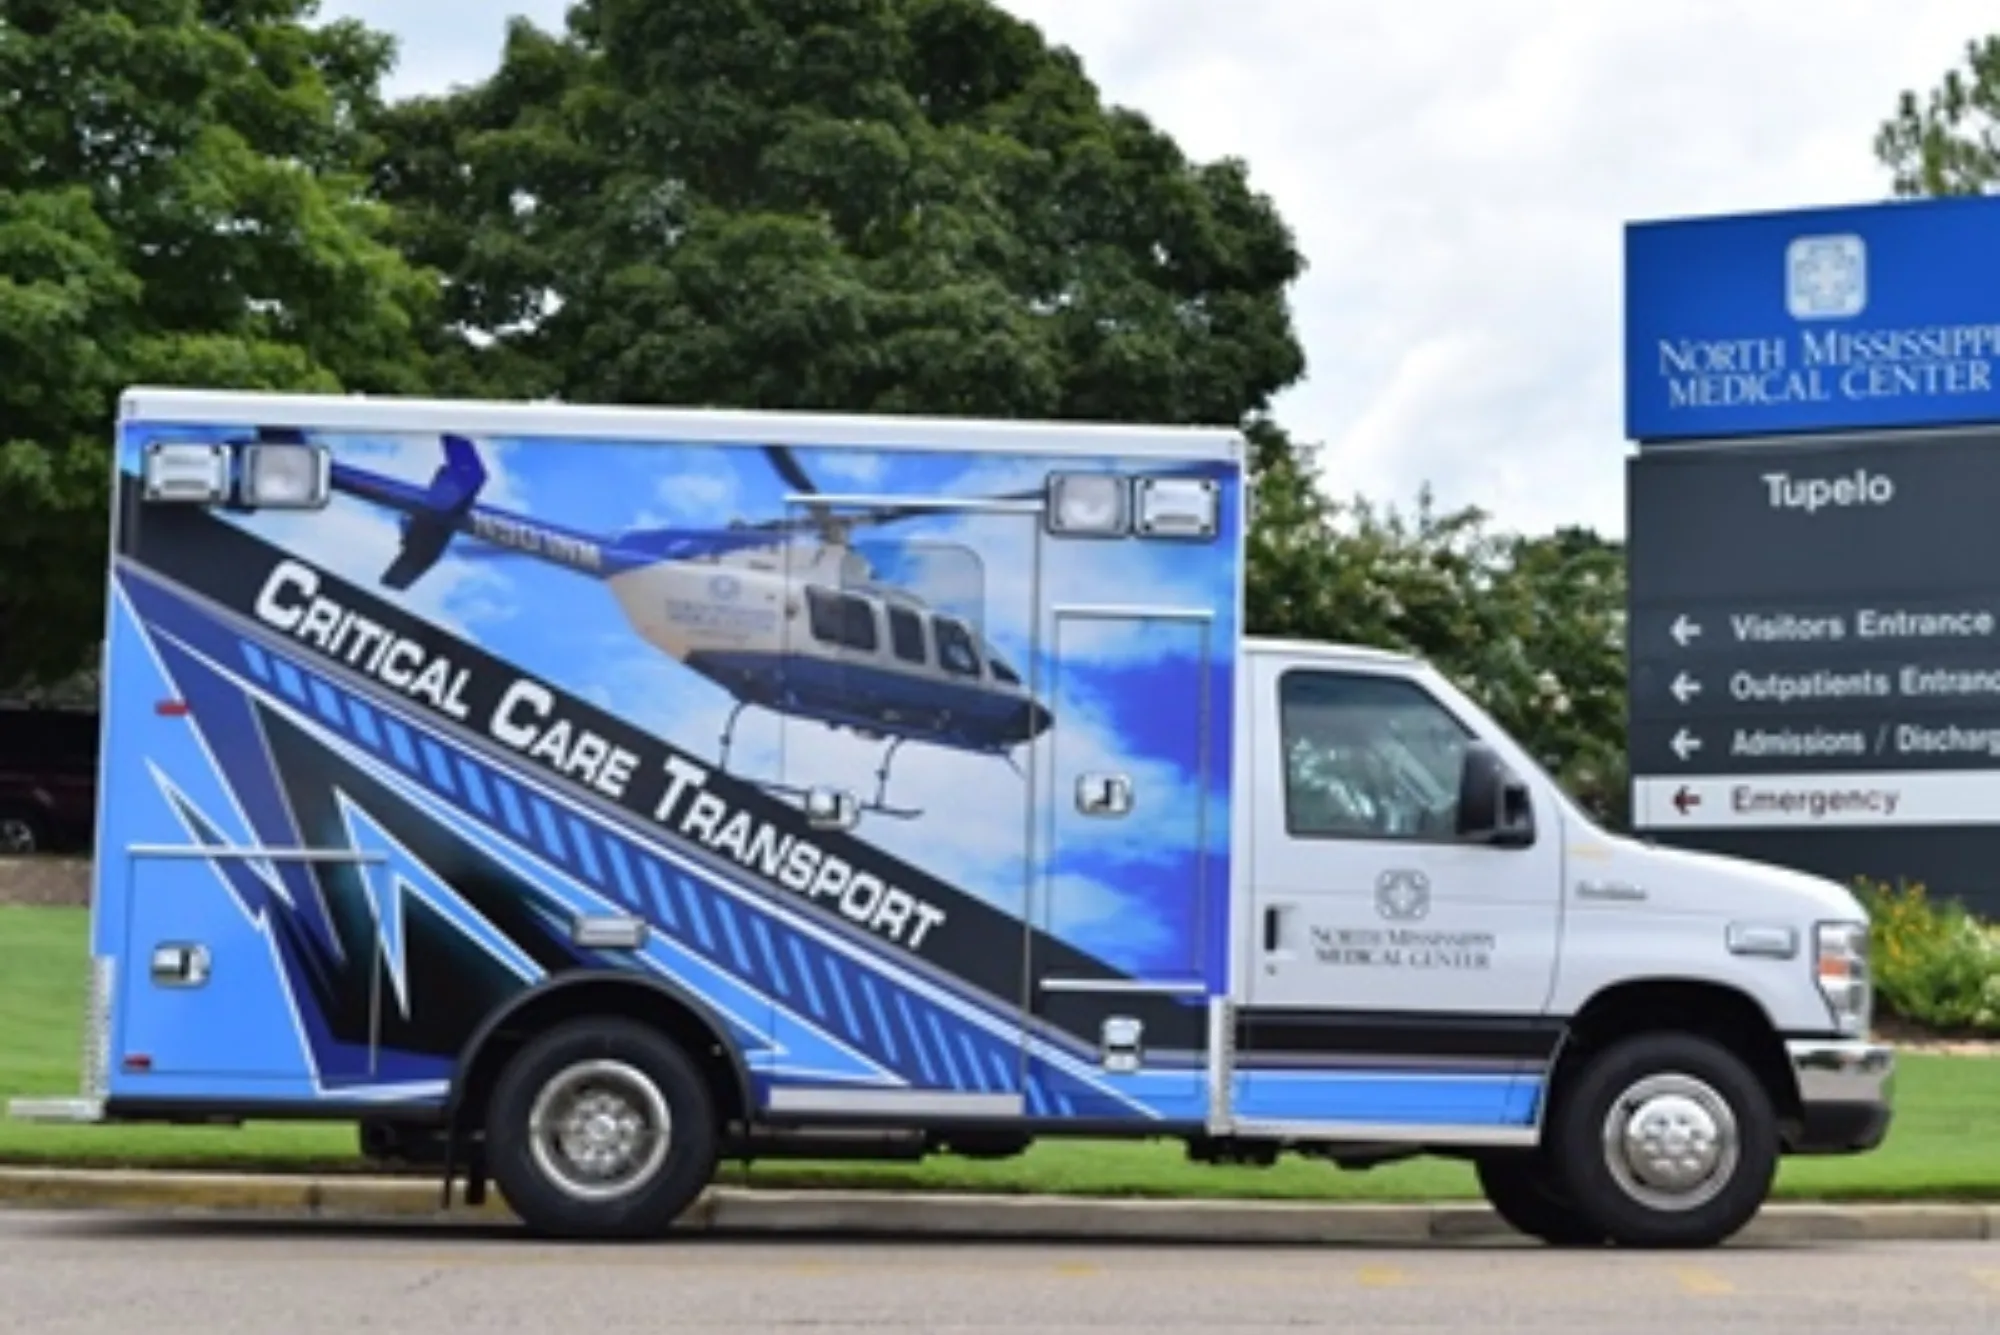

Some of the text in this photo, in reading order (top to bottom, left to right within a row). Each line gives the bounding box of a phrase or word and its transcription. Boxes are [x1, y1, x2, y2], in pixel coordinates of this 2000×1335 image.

[1658, 338, 1786, 376] NORTH
[1669, 360, 1992, 408] MEDICAL CENTER
[1761, 469, 1895, 513] Tupelo
[1730, 610, 1994, 641] Visitors Entrance
[1730, 670, 1891, 702] Outpatients
[254, 559, 946, 949] CRITICAL CARE TRANSPORT
[1730, 728, 1866, 756] Admissions
[1731, 786, 1900, 816] Emergency
[1310, 925, 1381, 946] NORTH
[1315, 948, 1491, 970] MEDICAL CENTER
